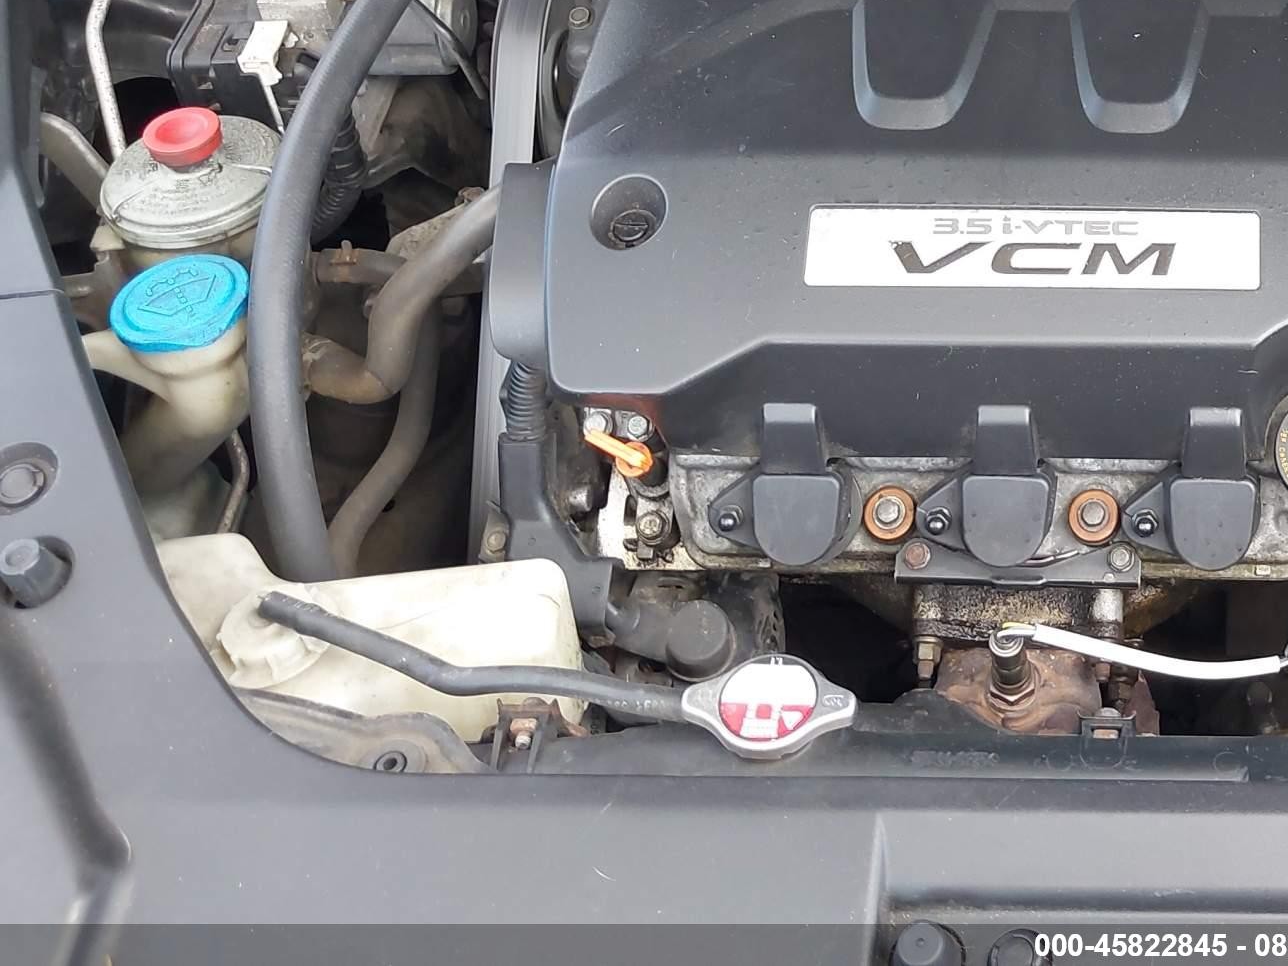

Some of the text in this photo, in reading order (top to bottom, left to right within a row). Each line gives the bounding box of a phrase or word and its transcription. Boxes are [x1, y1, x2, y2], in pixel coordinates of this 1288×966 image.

[933, 215, 1139, 236] 3.5 i-VTEC
[888, 240, 1177, 276] VCM
